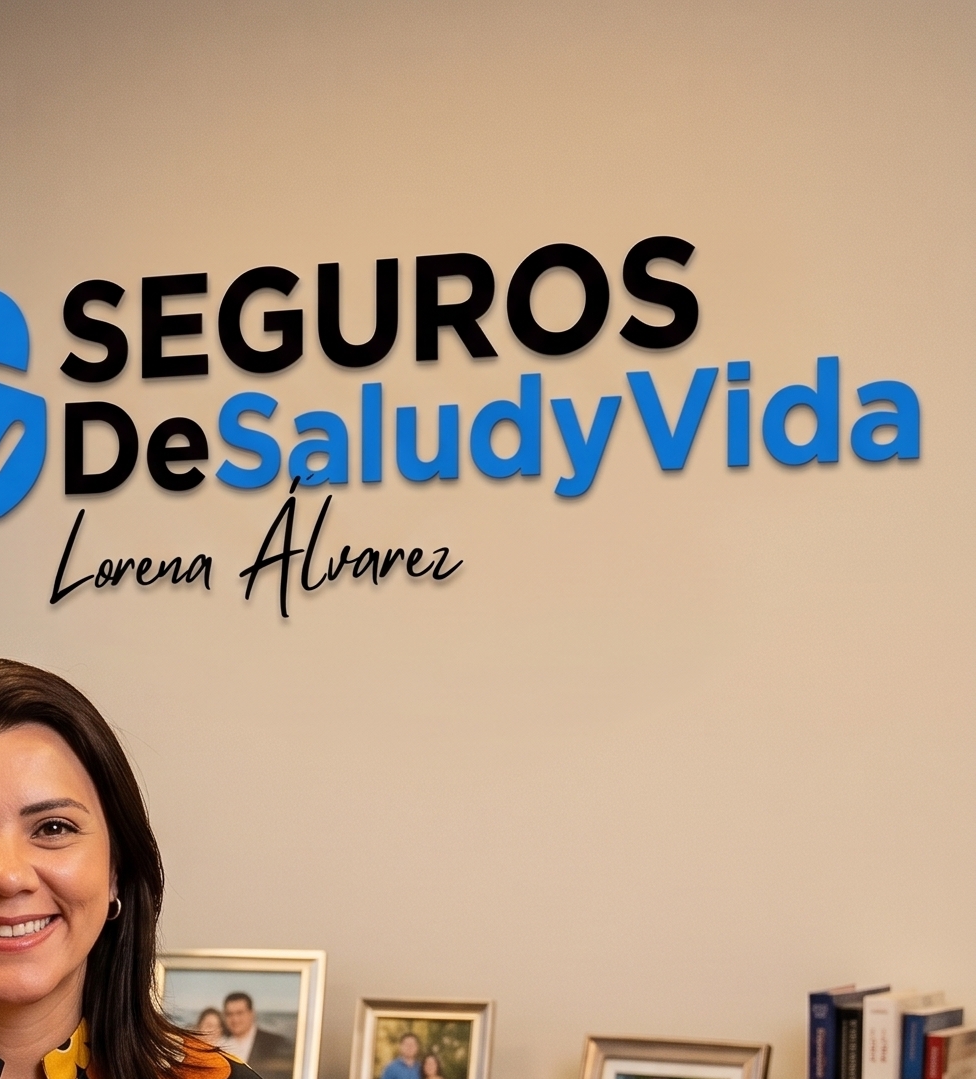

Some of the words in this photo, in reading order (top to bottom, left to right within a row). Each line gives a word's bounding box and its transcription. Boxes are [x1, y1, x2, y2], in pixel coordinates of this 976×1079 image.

[59, 235, 699, 384] SEGUROS
[64, 356, 921, 497] DeSaludyVida
[49, 508, 213, 605] Lorena
[239, 475, 464, 618] Álvarez
